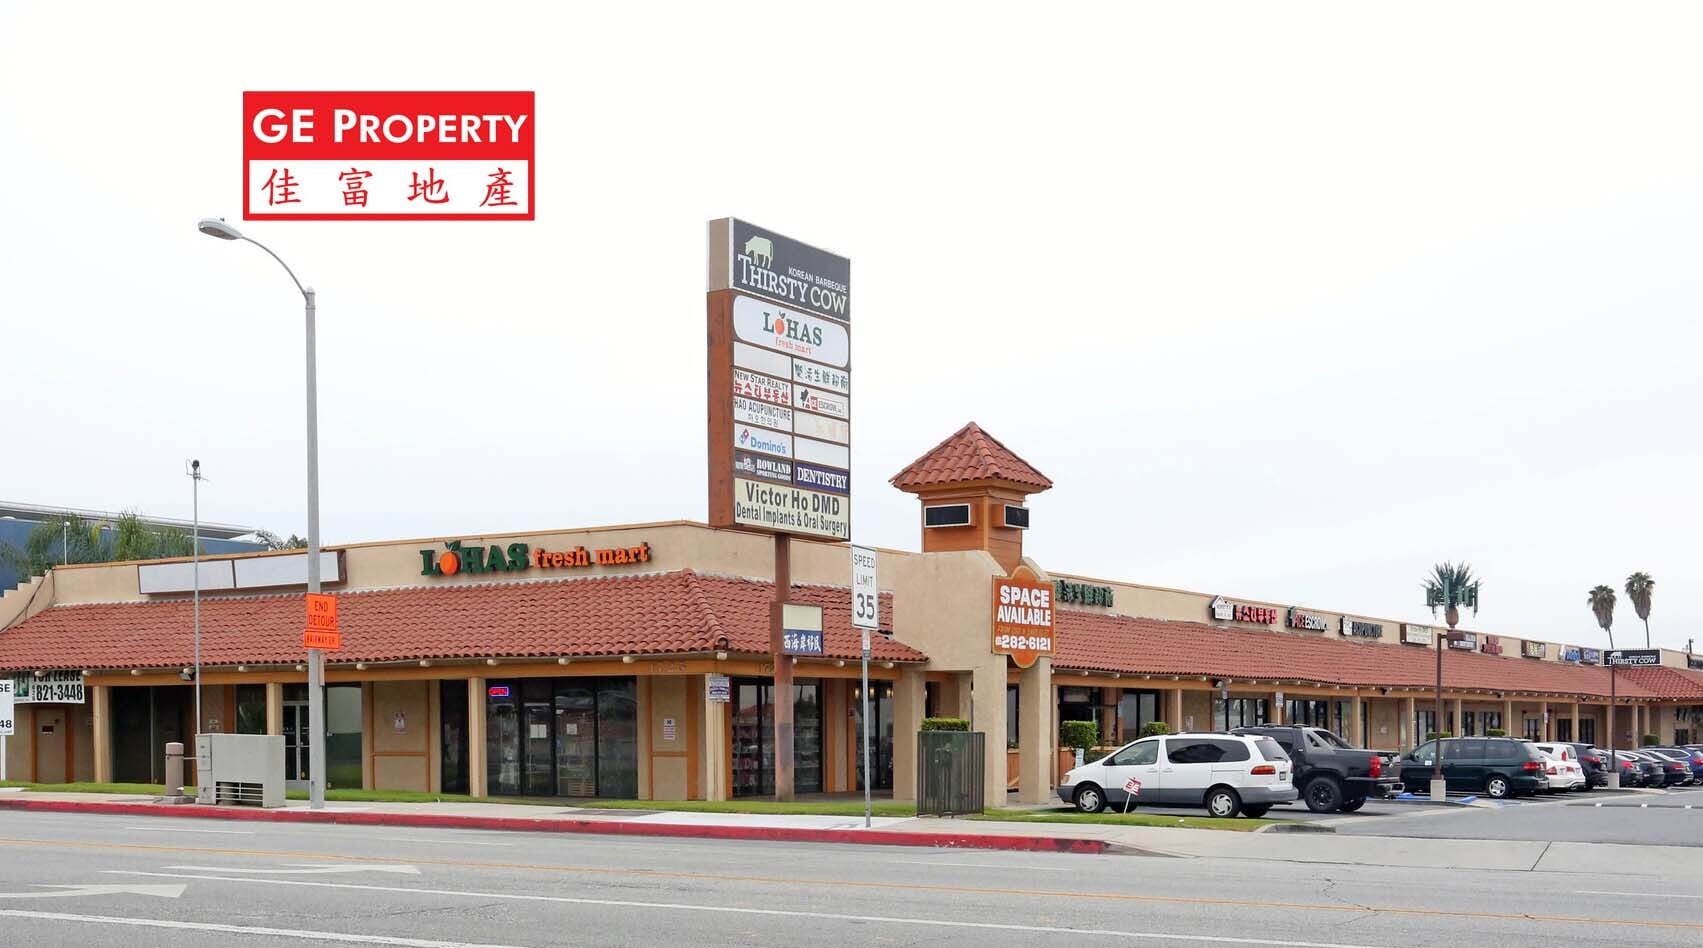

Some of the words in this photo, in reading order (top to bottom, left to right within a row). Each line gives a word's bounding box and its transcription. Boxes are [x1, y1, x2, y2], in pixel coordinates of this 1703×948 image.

[737, 254, 808, 303] THIRSTY
[810, 286, 847, 315] COW
[788, 266, 814, 283] KOREAN
[815, 275, 847, 294] BARBEQUE
[762, 311, 823, 347] LOHAS
[775, 337, 794, 351] fresh
[734, 370, 750, 381] NEW
[750, 374, 766, 386] STAR
[766, 378, 789, 391] REALTY
[734, 380, 789, 404] 뉴스타부동산
[735, 398, 747, 411] HAO
[748, 401, 791, 421] ACUPUNCTURE
[750, 436, 787, 454] Domino's
[756, 458, 791, 475] ROWLAND
[797, 467, 848, 489] DENTISTRY
[746, 481, 788, 508] Victor
[791, 490, 809, 511] Ho
[812, 494, 840, 516] DMD
[736, 501, 760, 521] Dental
[763, 506, 796, 526] Implants
[797, 511, 802, 527] &
[804, 513, 819, 530] Oral
[820, 515, 848, 538] Surgery
[419, 541, 530, 577] LOHAS
[533, 545, 591, 569] fresh
[594, 541, 652, 566] mart
[854, 554, 875, 569] SPEED
[856, 573, 873, 587] LIMIT
[314, 600, 329, 612] END
[856, 593, 875, 620] 35
[1000, 584, 1050, 608] SPACE
[308, 614, 335, 627] DETOUR
[997, 604, 1051, 627] AVAILABLE
[53, 670, 81, 682] LEASE
[36, 684, 83, 701] 821-3448
